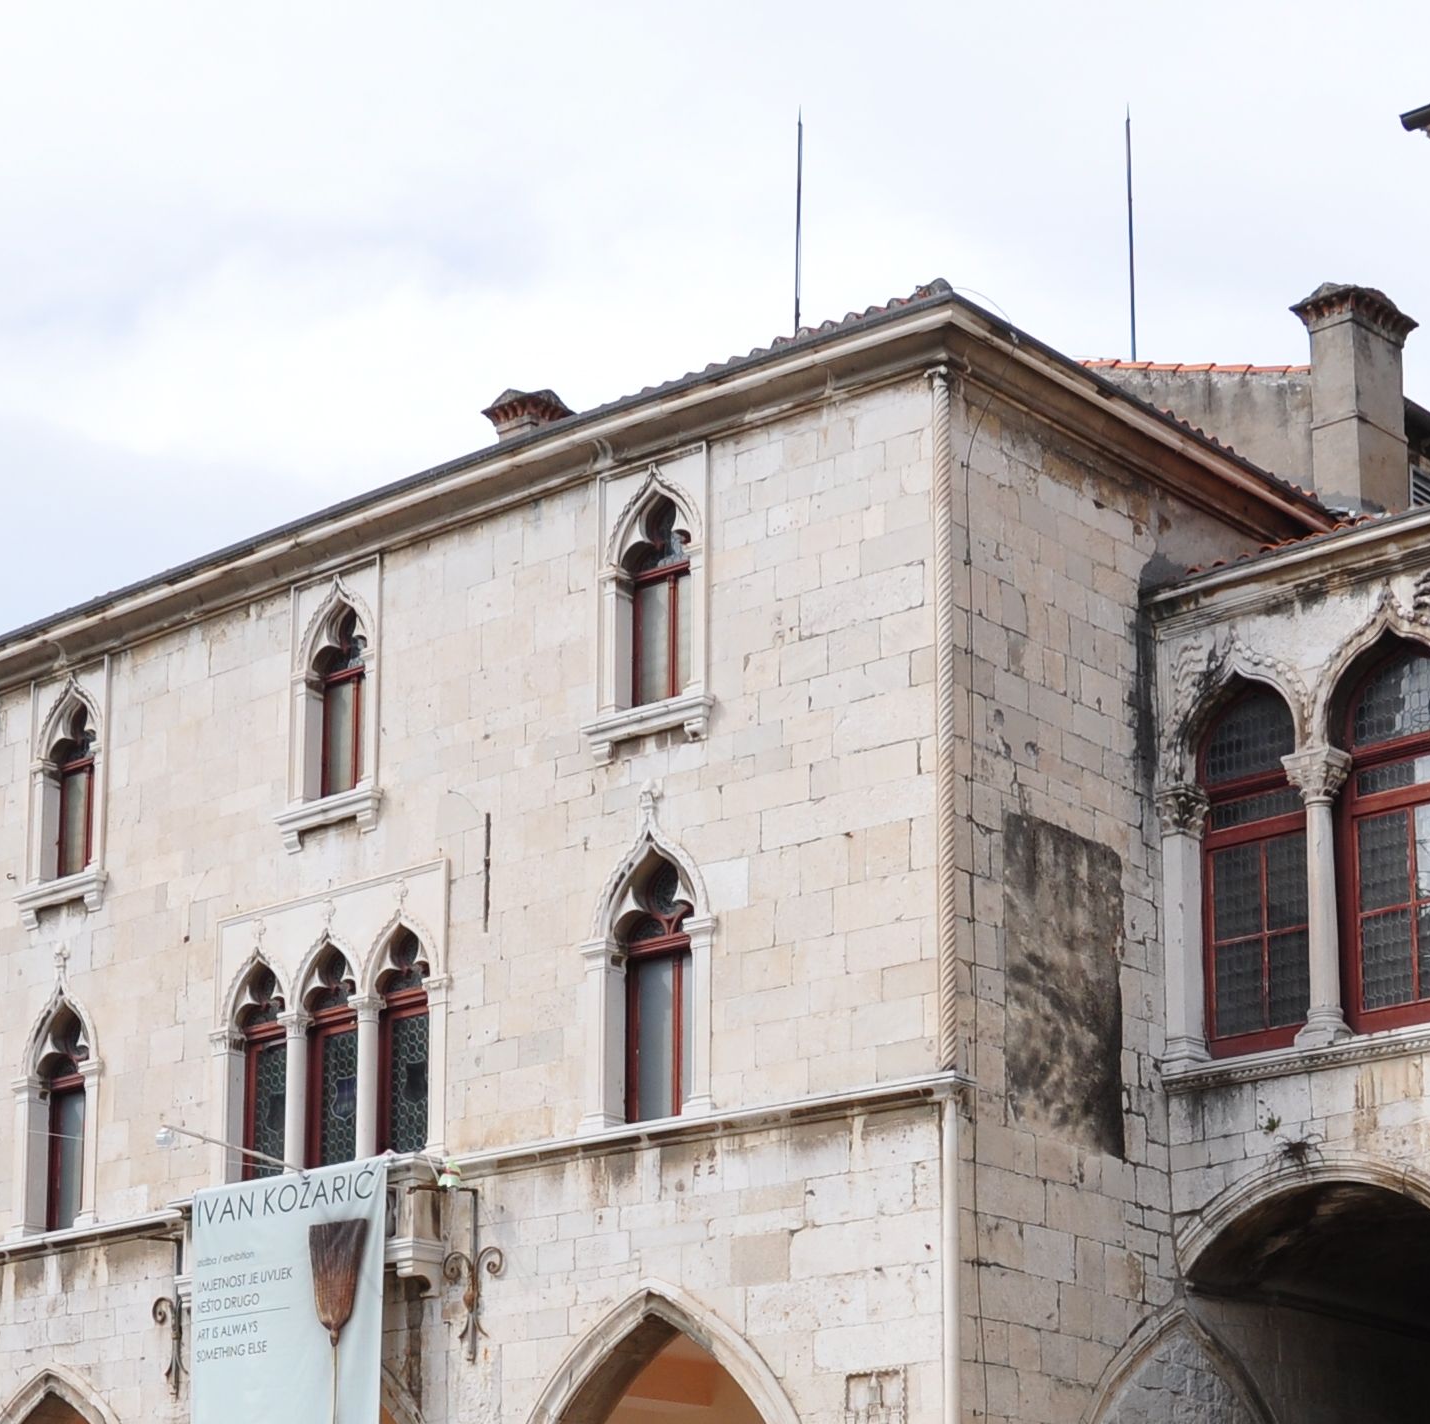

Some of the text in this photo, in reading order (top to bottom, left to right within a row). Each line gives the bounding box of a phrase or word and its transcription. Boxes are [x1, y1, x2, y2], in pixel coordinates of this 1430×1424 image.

[197, 1162, 375, 1228] IVAN KOŽARIĆ
[222, 1250, 255, 1263] exhibition
[248, 1271, 259, 1286] JE
[260, 1266, 293, 1284] UVIJEK
[223, 1292, 261, 1311] DRUGO
[196, 1320, 259, 1342] ART IS ALWAYS
[196, 1339, 268, 1364] SOMETHING ELSE
